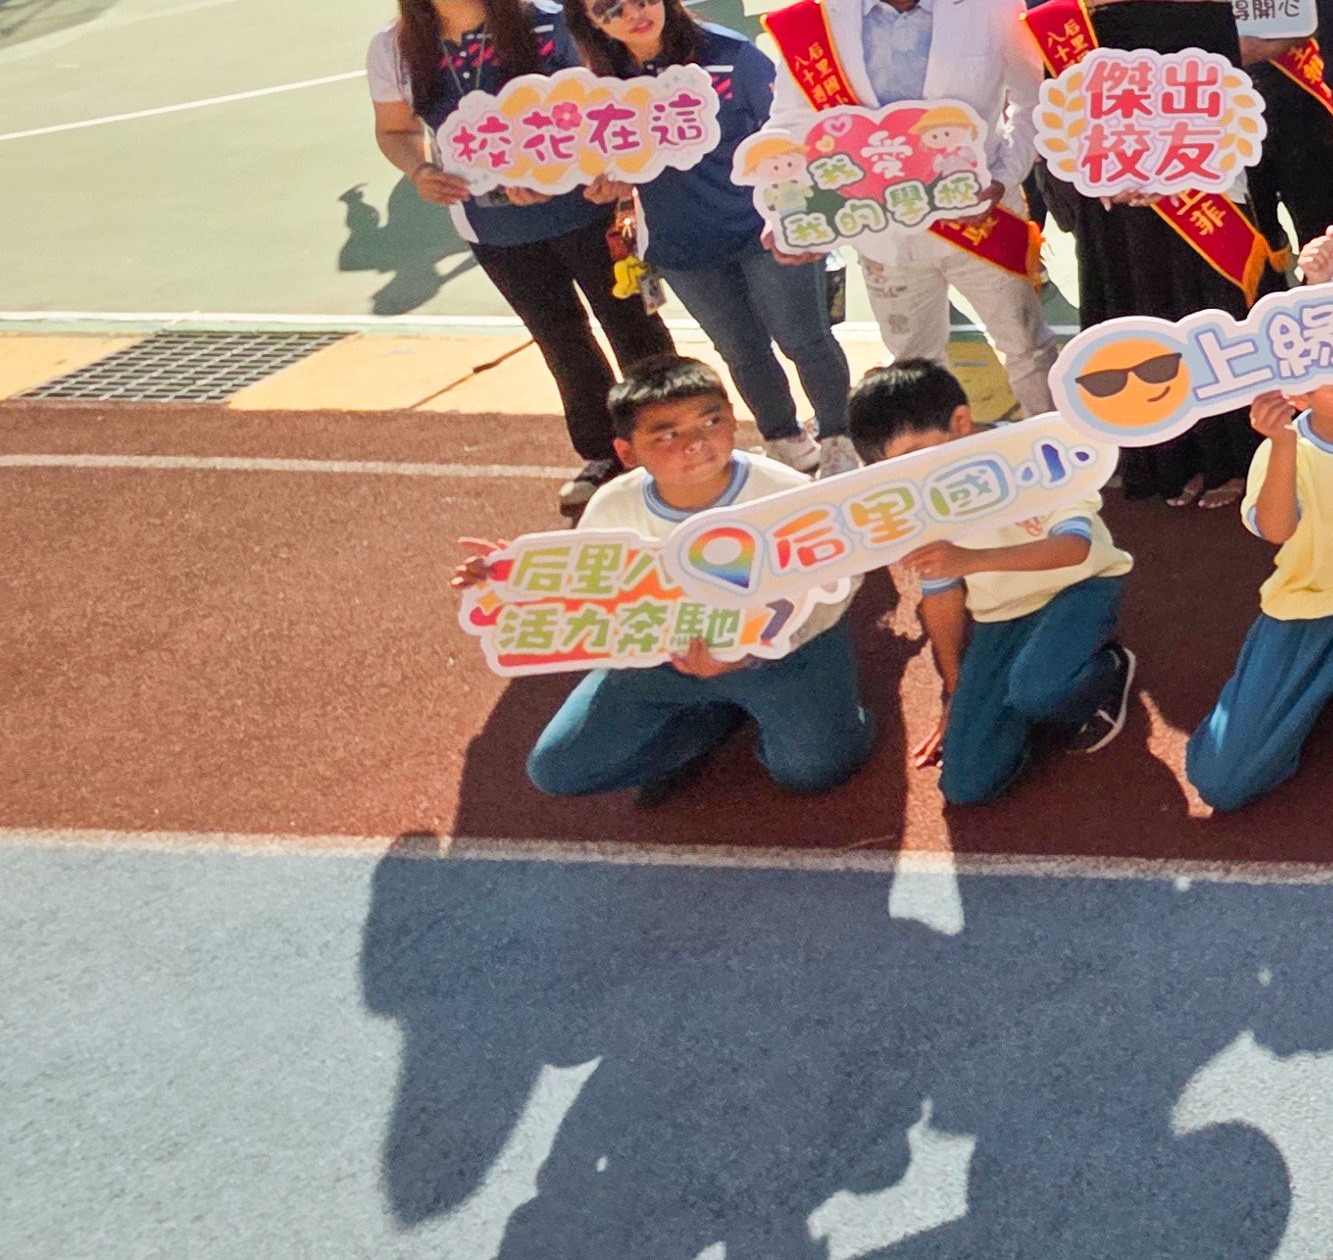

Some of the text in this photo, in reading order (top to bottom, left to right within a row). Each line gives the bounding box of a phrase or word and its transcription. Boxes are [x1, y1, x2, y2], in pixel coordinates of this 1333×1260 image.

[795, 54, 831, 108] 八十週
[1086, 60, 1220, 119] 傑出
[452, 93, 702, 168] 校花在這
[1082, 122, 1222, 183] 校友
[788, 171, 978, 242] 我的學校
[771, 442, 1098, 571] 后里國小
[500, 600, 744, 652] 活力奔馳
